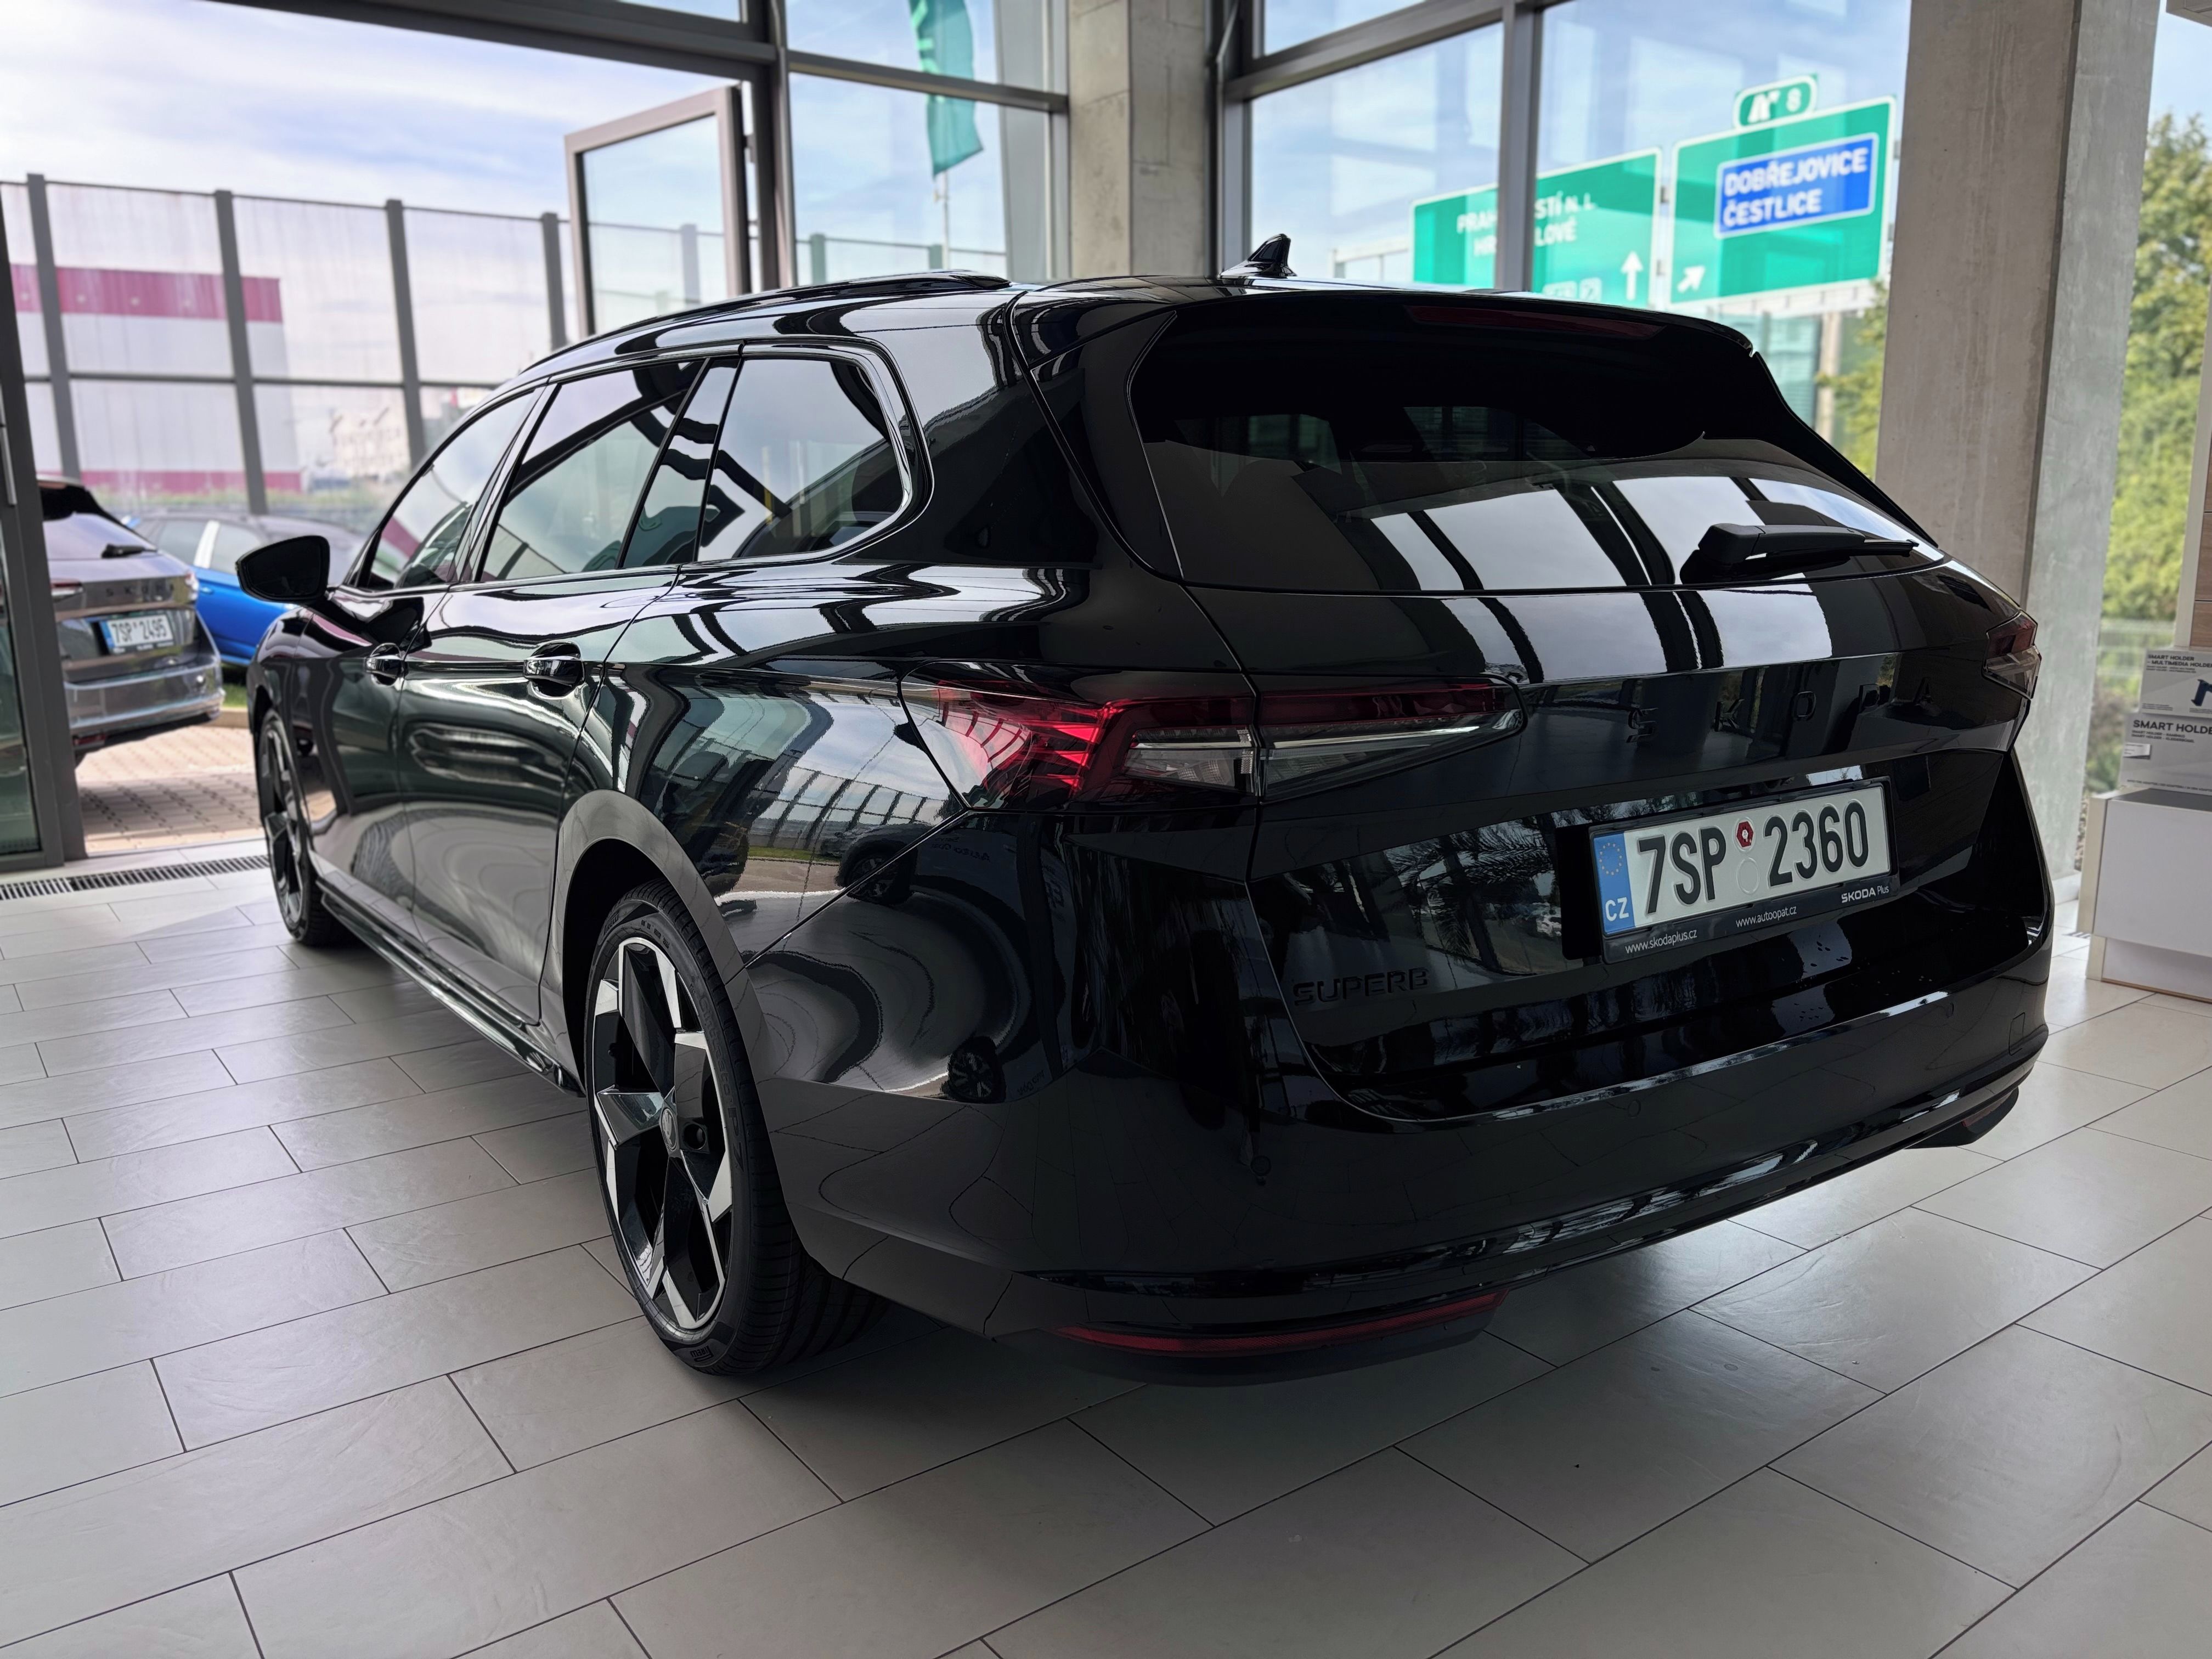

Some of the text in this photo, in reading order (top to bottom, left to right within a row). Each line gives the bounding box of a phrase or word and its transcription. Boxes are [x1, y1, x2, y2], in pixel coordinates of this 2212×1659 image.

[1724, 146, 1868, 197] DOBŘEJOVICE
[1457, 211, 1498, 234] PRAH
[1534, 190, 1563, 219] STÍ
[1723, 188, 1822, 228] ČESTLICE
[1534, 215, 1576, 247] LOVÉ
[2133, 719, 2212, 735] SMART HOLDE
[1638, 801, 1869, 914] 7SP 2360
[1877, 885, 1889, 895] Plus
[1605, 897, 1629, 922] CZ
[1735, 906, 1797, 928] www.autoopat.cz
[1624, 929, 1697, 954] www.skodaplus.cz
[1293, 967, 1429, 1006] SUPERB
